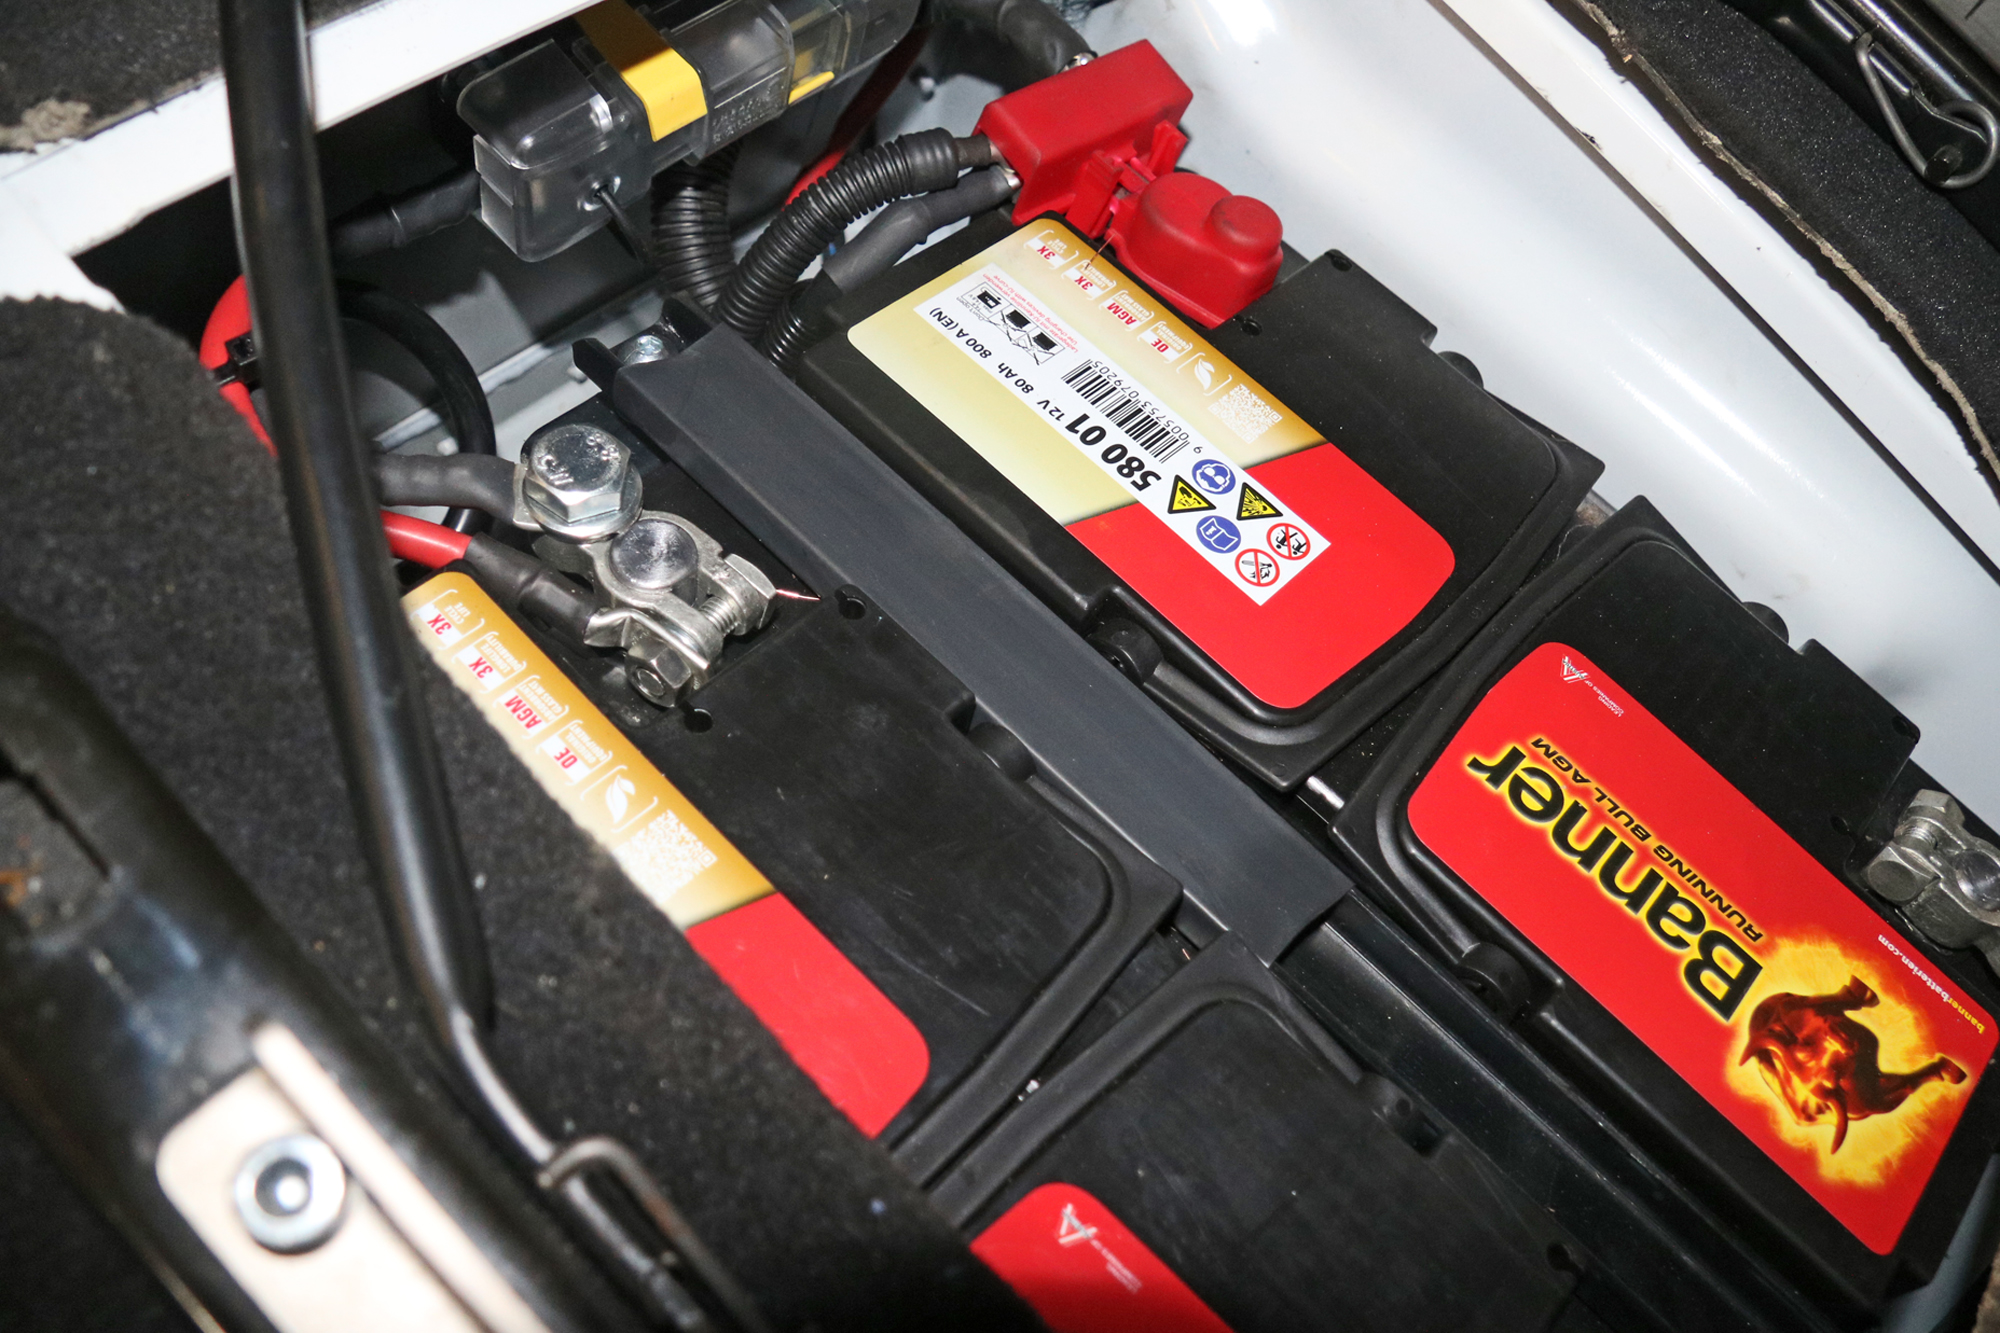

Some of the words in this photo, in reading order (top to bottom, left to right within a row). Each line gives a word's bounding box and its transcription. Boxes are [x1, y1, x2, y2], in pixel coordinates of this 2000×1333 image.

[1037, 245, 1055, 259] 3X
[1075, 276, 1093, 290] 3X
[929, 308, 958, 330] (EN)
[1107, 302, 1136, 324] AGM
[956, 328, 969, 337] A
[965, 338, 991, 358] 800
[1151, 338, 1168, 352] OE
[998, 363, 1017, 378] Ah
[1092, 361, 1139, 398] 079205
[1014, 378, 1033, 393] 80
[1065, 413, 1106, 445] 01
[1141, 401, 1189, 440] 005753
[1101, 444, 1161, 491] 580
[444, 604, 465, 624] CYCLE
[454, 602, 470, 617] LIFE
[428, 614, 451, 634] 3X
[480, 643, 511, 672] LONGLIFE
[485, 633, 522, 670] DURABILITY
[469, 657, 492, 678] 3X
[517, 684, 556, 720] ABSORBENT
[540, 692, 562, 713] GLASS
[1593, 686, 1624, 713] COMPANIES
[1597, 696, 1621, 716] LEADING
[505, 696, 541, 728] AGM
[564, 732, 598, 764] ORIGINAL
[568, 722, 608, 760] EQUIPMENT
[555, 748, 577, 768] OE
[1532, 738, 1590, 782] AGM
[1595, 788, 1651, 841] BULL
[1468, 746, 1762, 1020] Banner
[1654, 845, 1762, 941] RUNNING
[1878, 935, 1986, 1034] bannerbatterien.com
